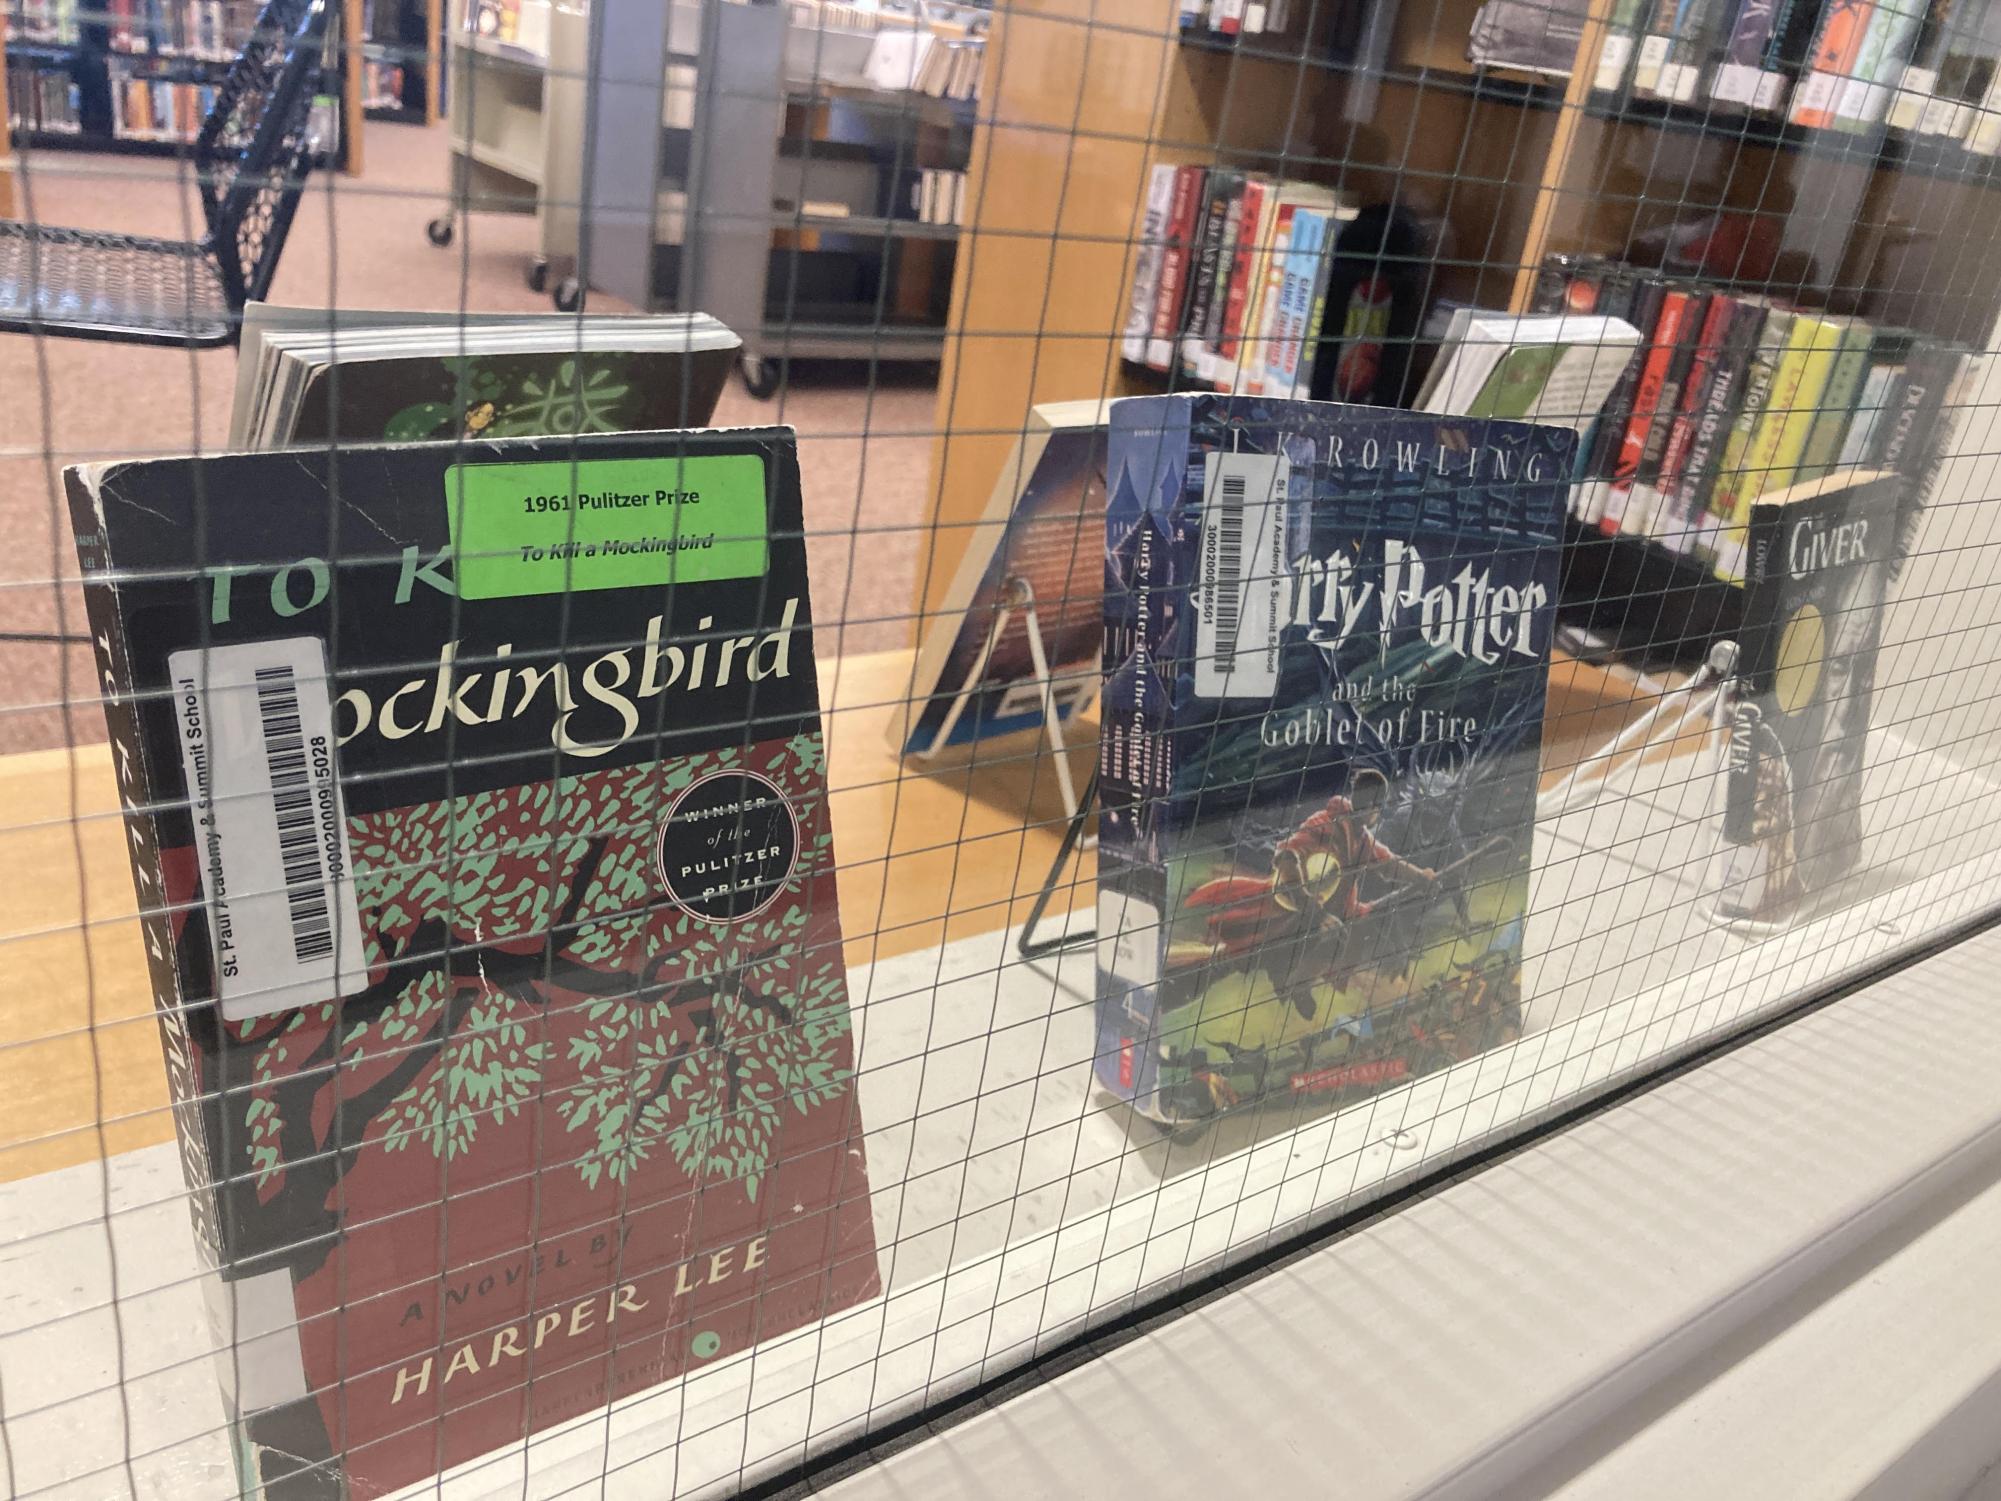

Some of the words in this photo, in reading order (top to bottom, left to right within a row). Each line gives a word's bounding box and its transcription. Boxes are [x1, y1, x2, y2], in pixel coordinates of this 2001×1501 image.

[1326, 434, 1545, 484] ROWLING
[524, 494, 573, 512] 1961
[578, 491, 650, 511] Pulitzer
[655, 489, 701, 507] Prize
[1275, 478, 1286, 494] St.
[83, 556, 96, 568] LEE
[520, 544, 543, 562] To
[549, 541, 582, 561] Kill
[585, 544, 597, 558] a
[602, 532, 714, 557] Mockingbird
[1138, 529, 1153, 581] Harry
[1270, 524, 1283, 576] Academy
[1788, 516, 1869, 581] GIVER
[202, 557, 331, 625] TO
[1287, 549, 1375, 651] rry
[1378, 538, 1549, 671] Potter
[1137, 584, 1150, 641] Potter
[1268, 590, 1280, 633] Summit
[1135, 641, 1148, 676] and
[1265, 634, 1278, 674] School
[334, 598, 800, 758] ockingbird
[1134, 679, 1147, 708] the
[1332, 675, 1373, 702] and
[1382, 675, 1417, 702] the
[177, 678, 203, 740] School
[1260, 707, 1364, 747] Goblet
[1378, 706, 1411, 745] of
[1420, 709, 1477, 744] Fire
[98, 627, 120, 706] TO
[116, 737, 152, 897] KILL
[147, 921, 163, 962] A
[189, 743, 213, 809] Summit
[200, 813, 216, 826] &
[684, 796, 768, 824] WINNER
[1130, 791, 1143, 828] Fre
[706, 828, 724, 849] of
[681, 845, 781, 878] PULITZER
[703, 875, 764, 899] PRIZE
[214, 913, 236, 951] Paul
[223, 954, 239, 978] St.
[400, 1301, 425, 1327] A
[445, 1247, 577, 1306] NOVEL
[390, 1283, 650, 1405] HARPER
[673, 1235, 769, 1299] LEE
